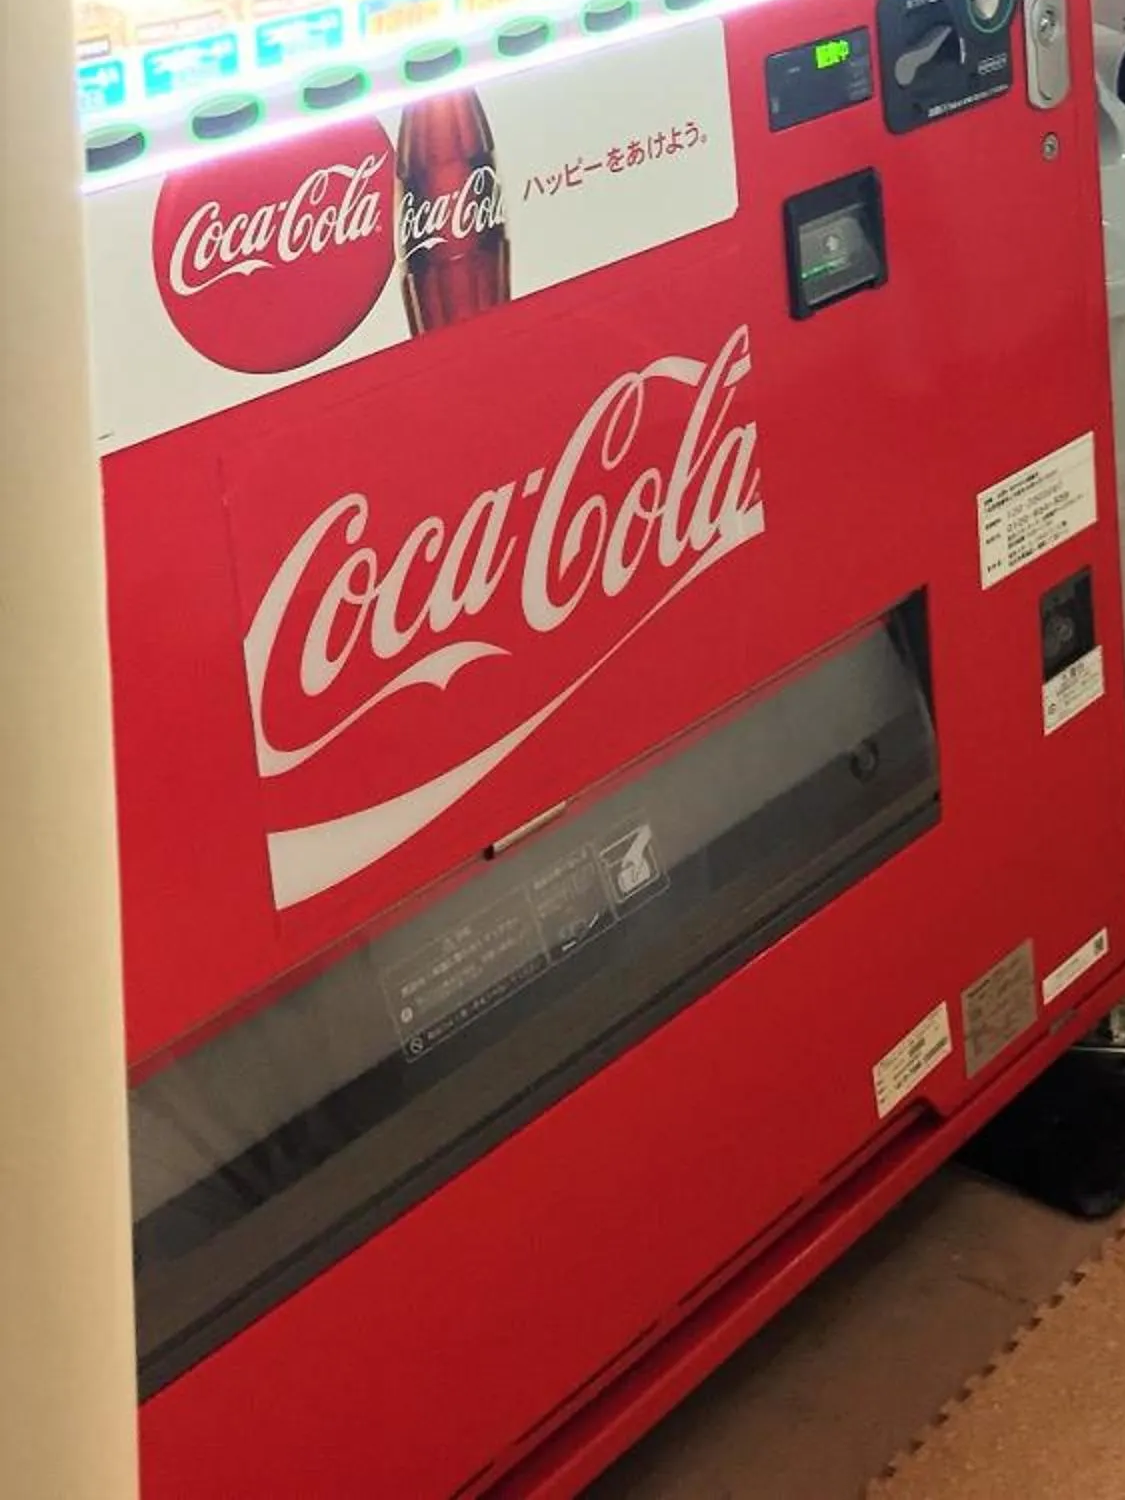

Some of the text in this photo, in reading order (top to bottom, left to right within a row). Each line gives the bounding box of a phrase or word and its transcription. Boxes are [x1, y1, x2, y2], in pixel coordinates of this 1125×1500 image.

[169, 150, 389, 296] Coca-Cola
[522, 121, 708, 202] ハッピーをあけよう。
[243, 323, 766, 779] Coca-Cola
